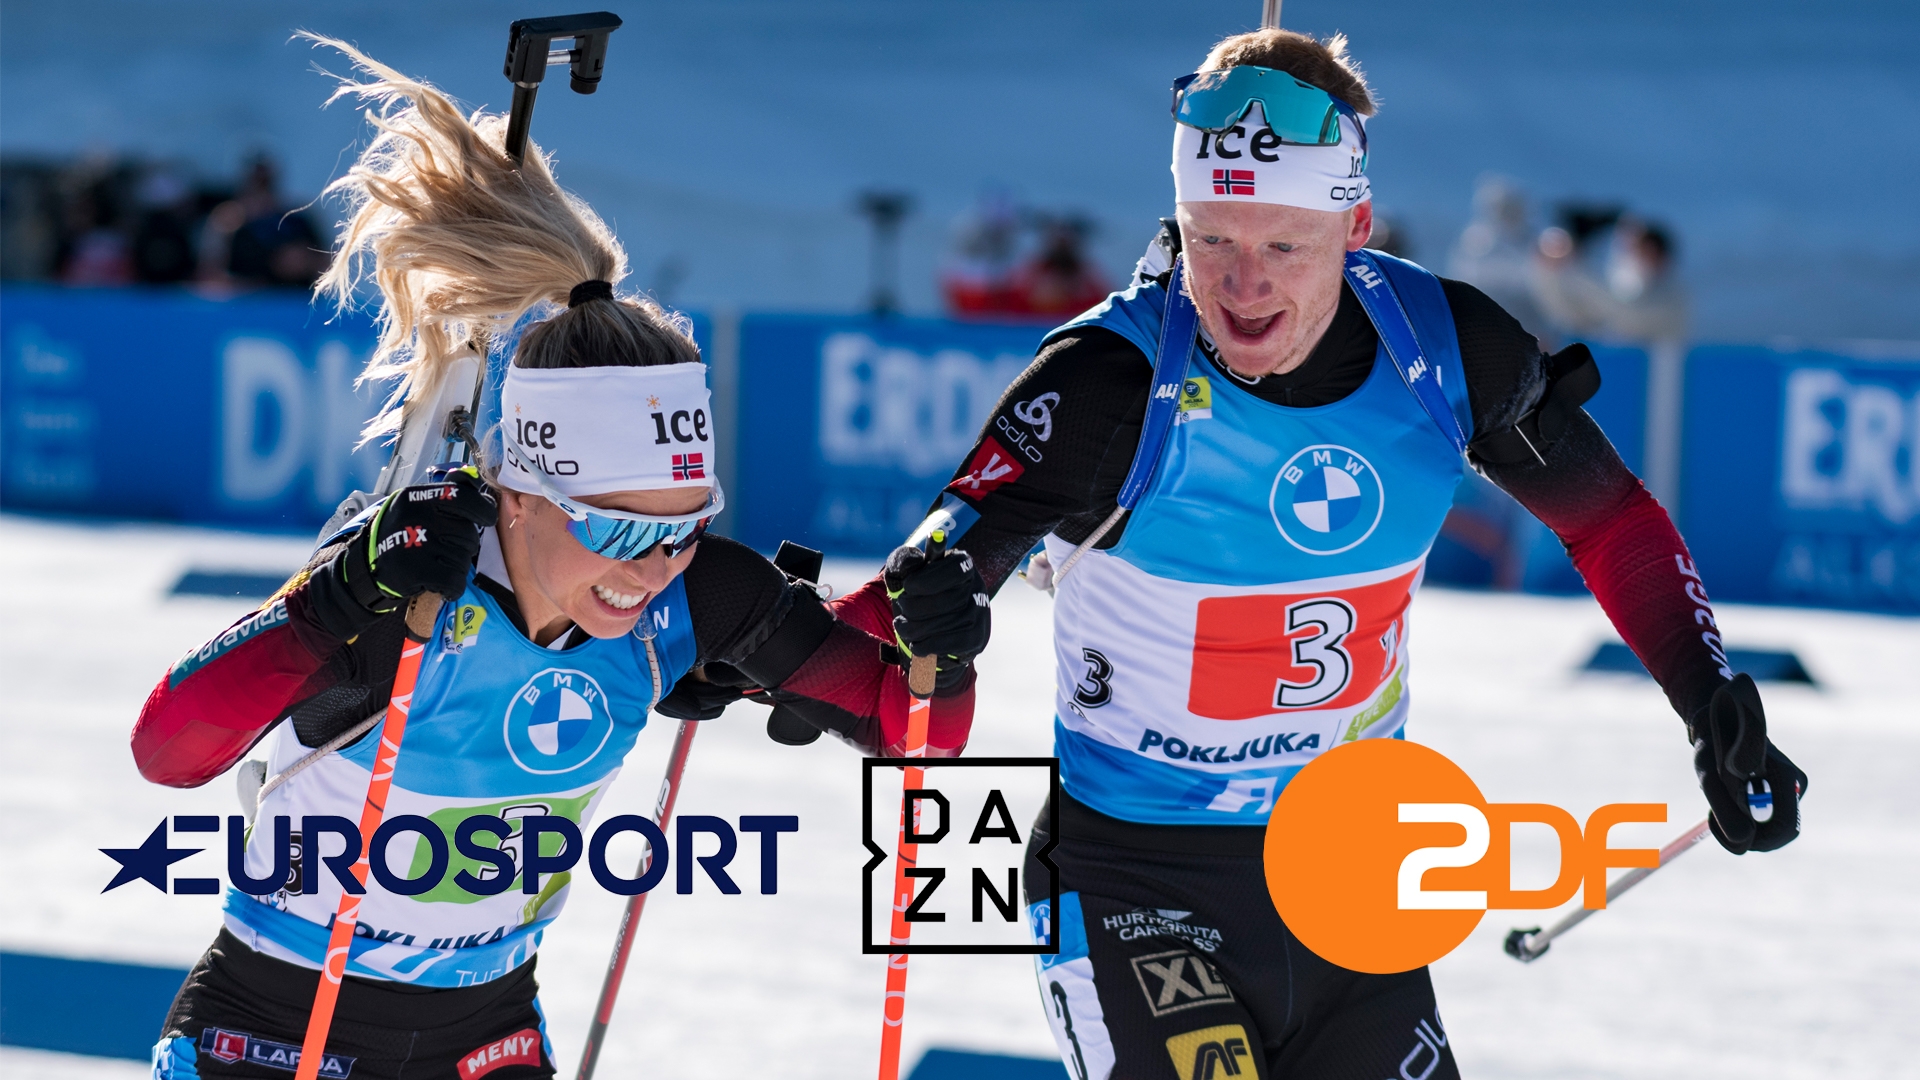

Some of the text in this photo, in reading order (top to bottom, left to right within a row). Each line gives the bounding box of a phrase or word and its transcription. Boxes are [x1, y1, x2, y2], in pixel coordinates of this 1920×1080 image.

[516, 418, 556, 450] ice
[651, 408, 709, 445] ice
[996, 415, 1043, 463] odlo
[1283, 450, 1364, 485] BMW
[1273, 597, 1357, 708] 3
[523, 672, 597, 706] BMW
[1073, 647, 1114, 709] 3
[1138, 728, 1320, 763] POKLJUKA
[1142, 956, 1229, 1007] XL
[467, 1036, 535, 1075] MENY
